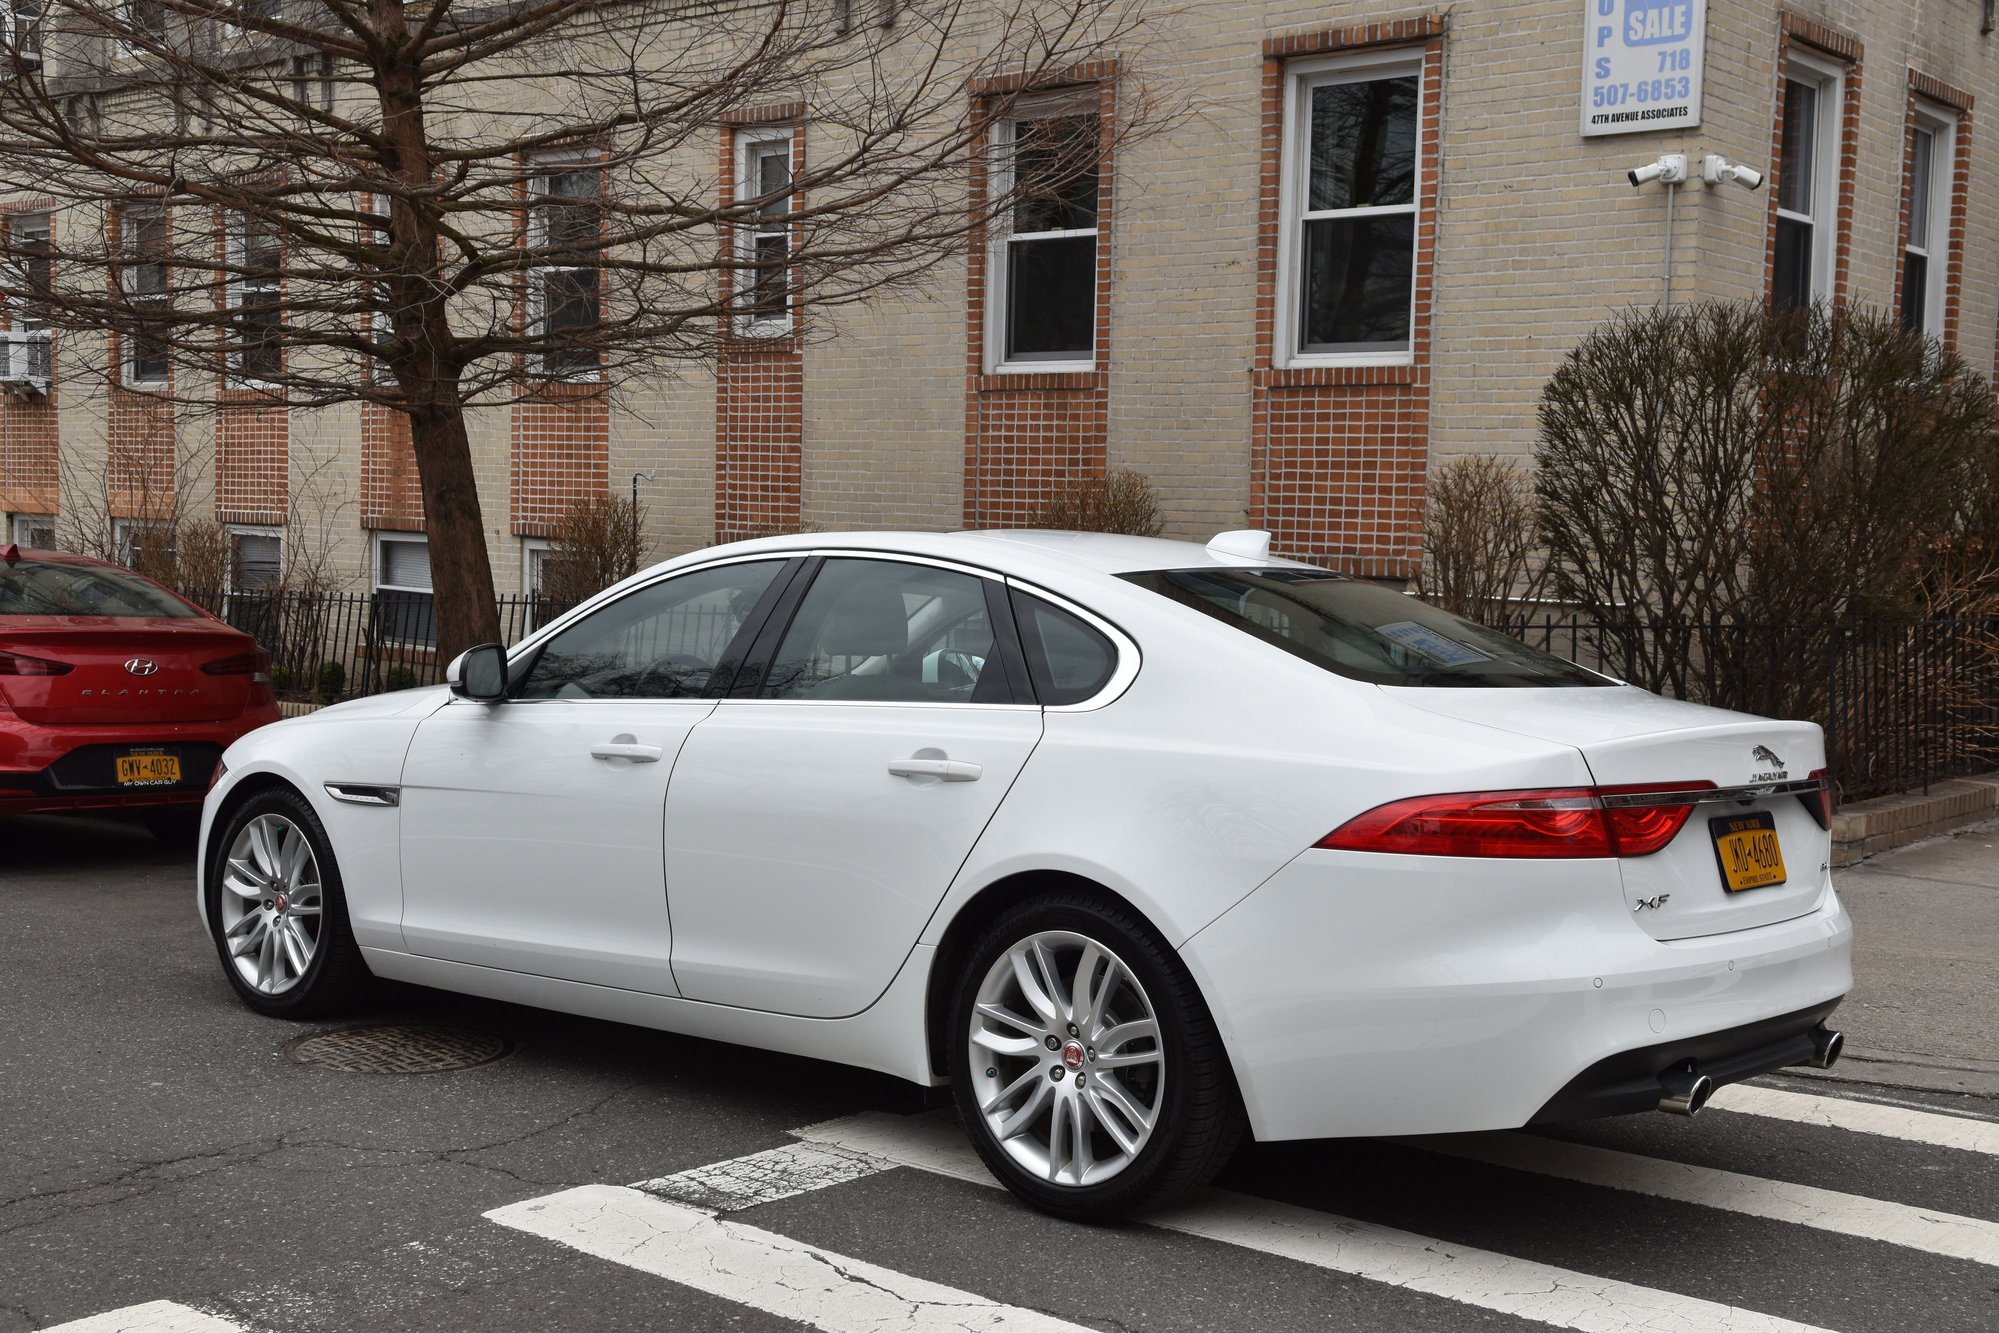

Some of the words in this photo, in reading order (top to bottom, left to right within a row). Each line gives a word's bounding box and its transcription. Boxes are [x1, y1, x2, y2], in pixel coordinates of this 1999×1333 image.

[1629, 5, 1686, 41] SALE
[1657, 48, 1691, 73] 718
[1592, 76, 1690, 108] 507-6853
[1591, 114, 1610, 125] 47TH
[1610, 111, 1639, 123] AVENUE
[1640, 106, 1688, 120] ASSOCIATES
[1633, 894, 1670, 912] XF
